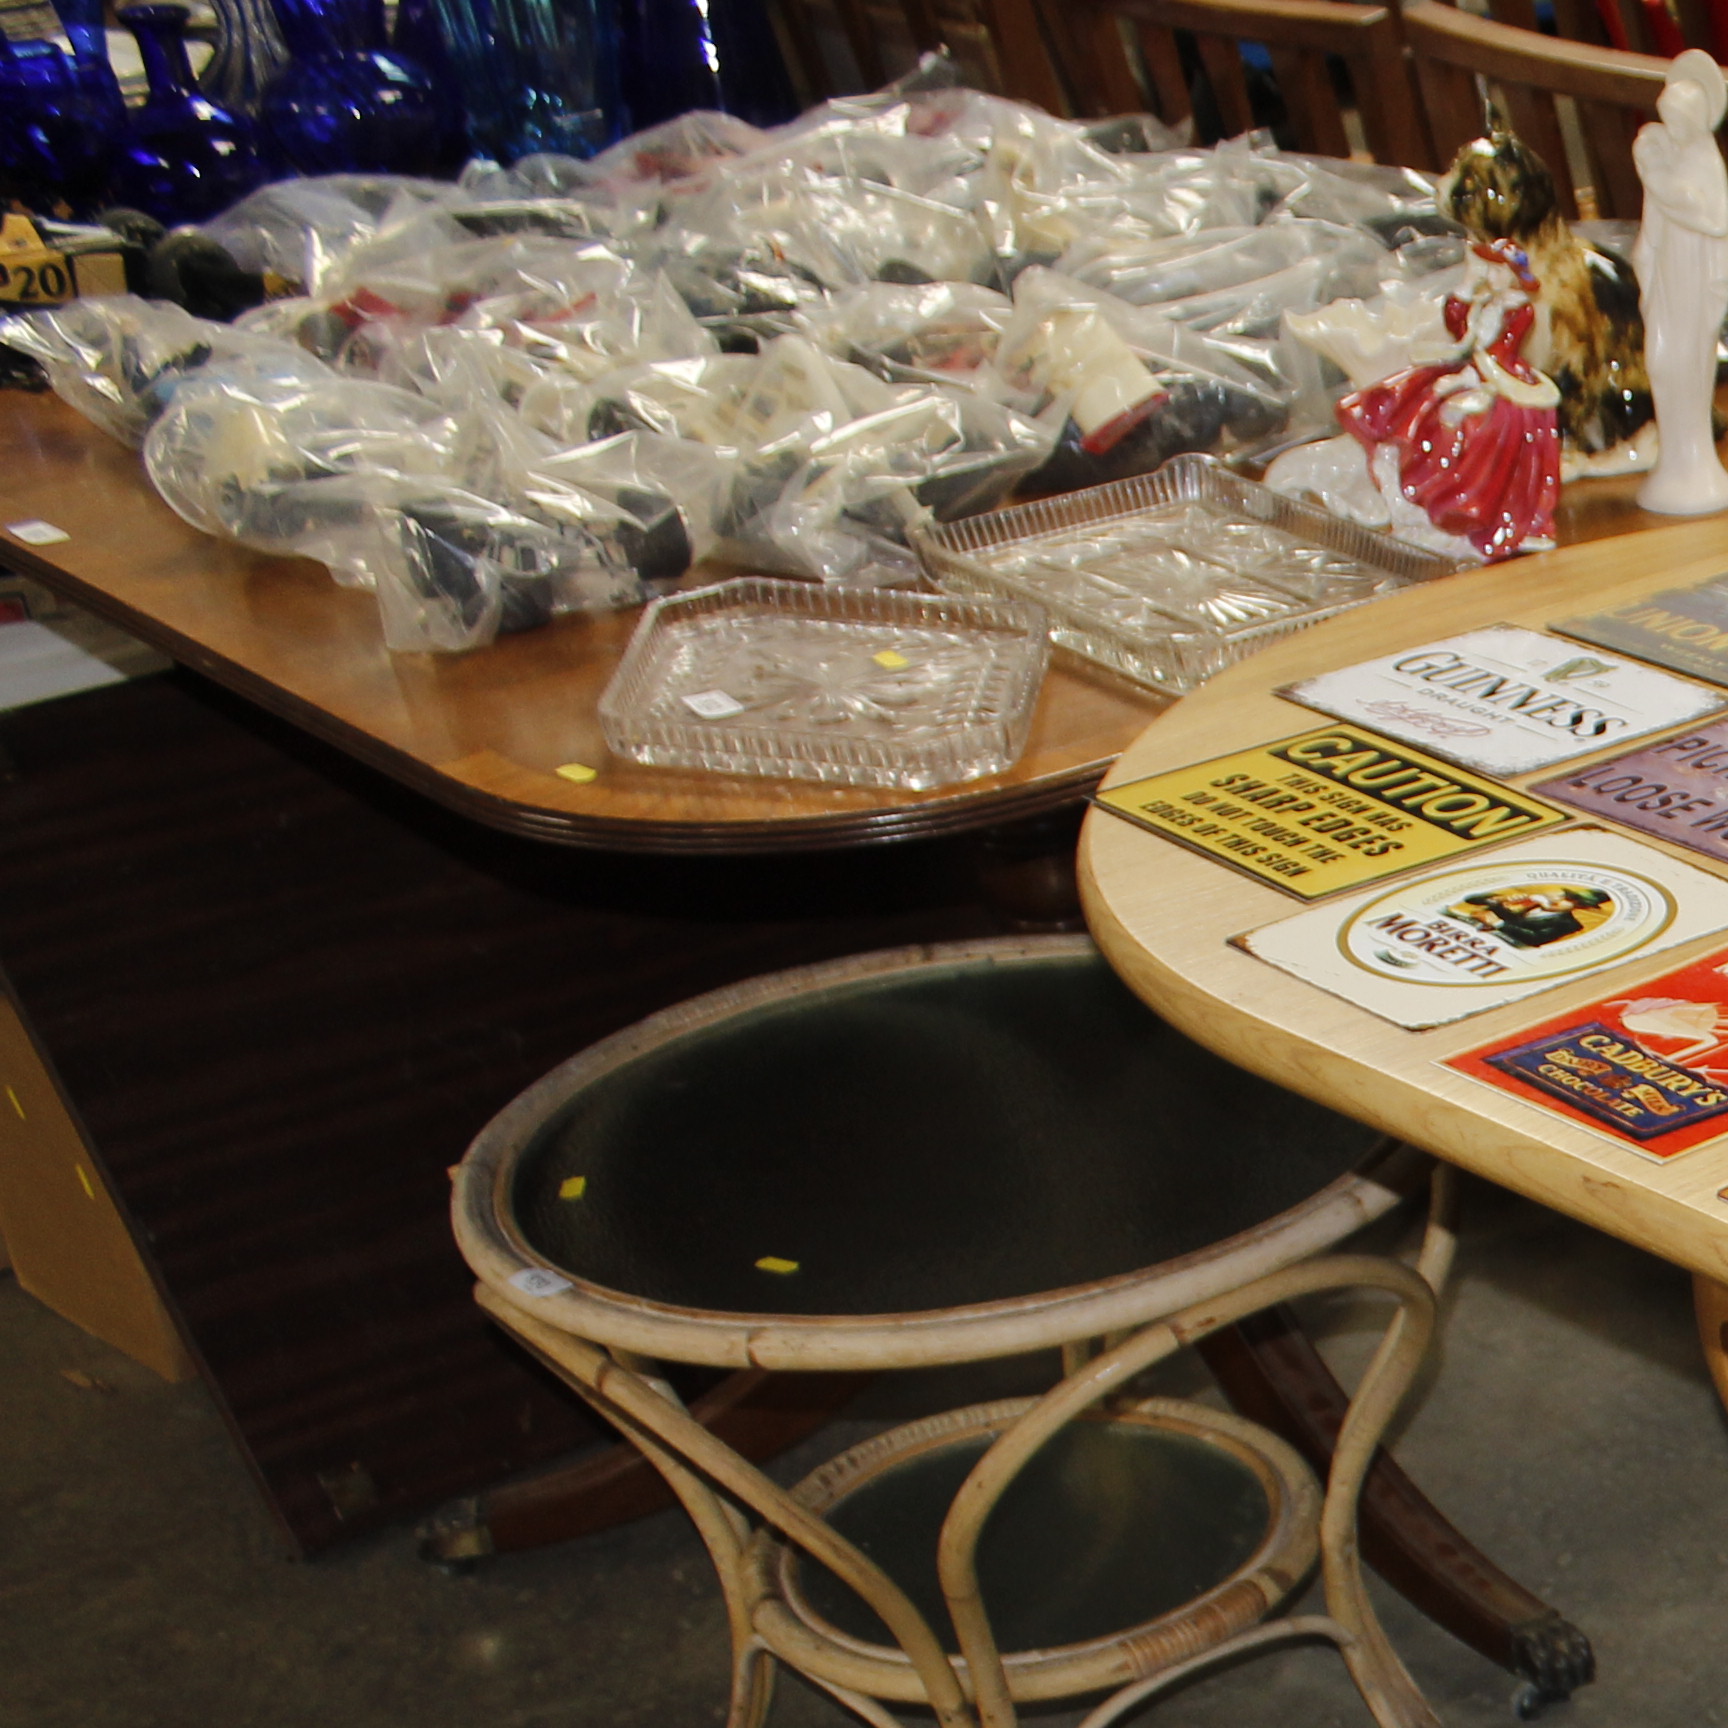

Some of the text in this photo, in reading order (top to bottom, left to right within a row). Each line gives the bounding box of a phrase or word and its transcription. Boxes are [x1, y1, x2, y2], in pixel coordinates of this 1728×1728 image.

[14, 263, 66, 299] 20
[1392, 651, 1630, 738] GUINNESS
[1416, 687, 1516, 725] DRAUGHT
[1209, 773, 1405, 858] SHARP EDGES
[1276, 772, 1414, 835] THIS SIGN HAS
[1286, 734, 1532, 840] CAUTION
[1567, 766, 1714, 820] LOOSE
[1139, 800, 1313, 879] EDGES OF THIS SIGN
[1181, 791, 1348, 866] DO NOT TOUCH THE
[1364, 910, 1515, 980] MORETTI
[1426, 917, 1500, 960] BIRRA
[1537, 1063, 1645, 1119] CHOCOLATE
